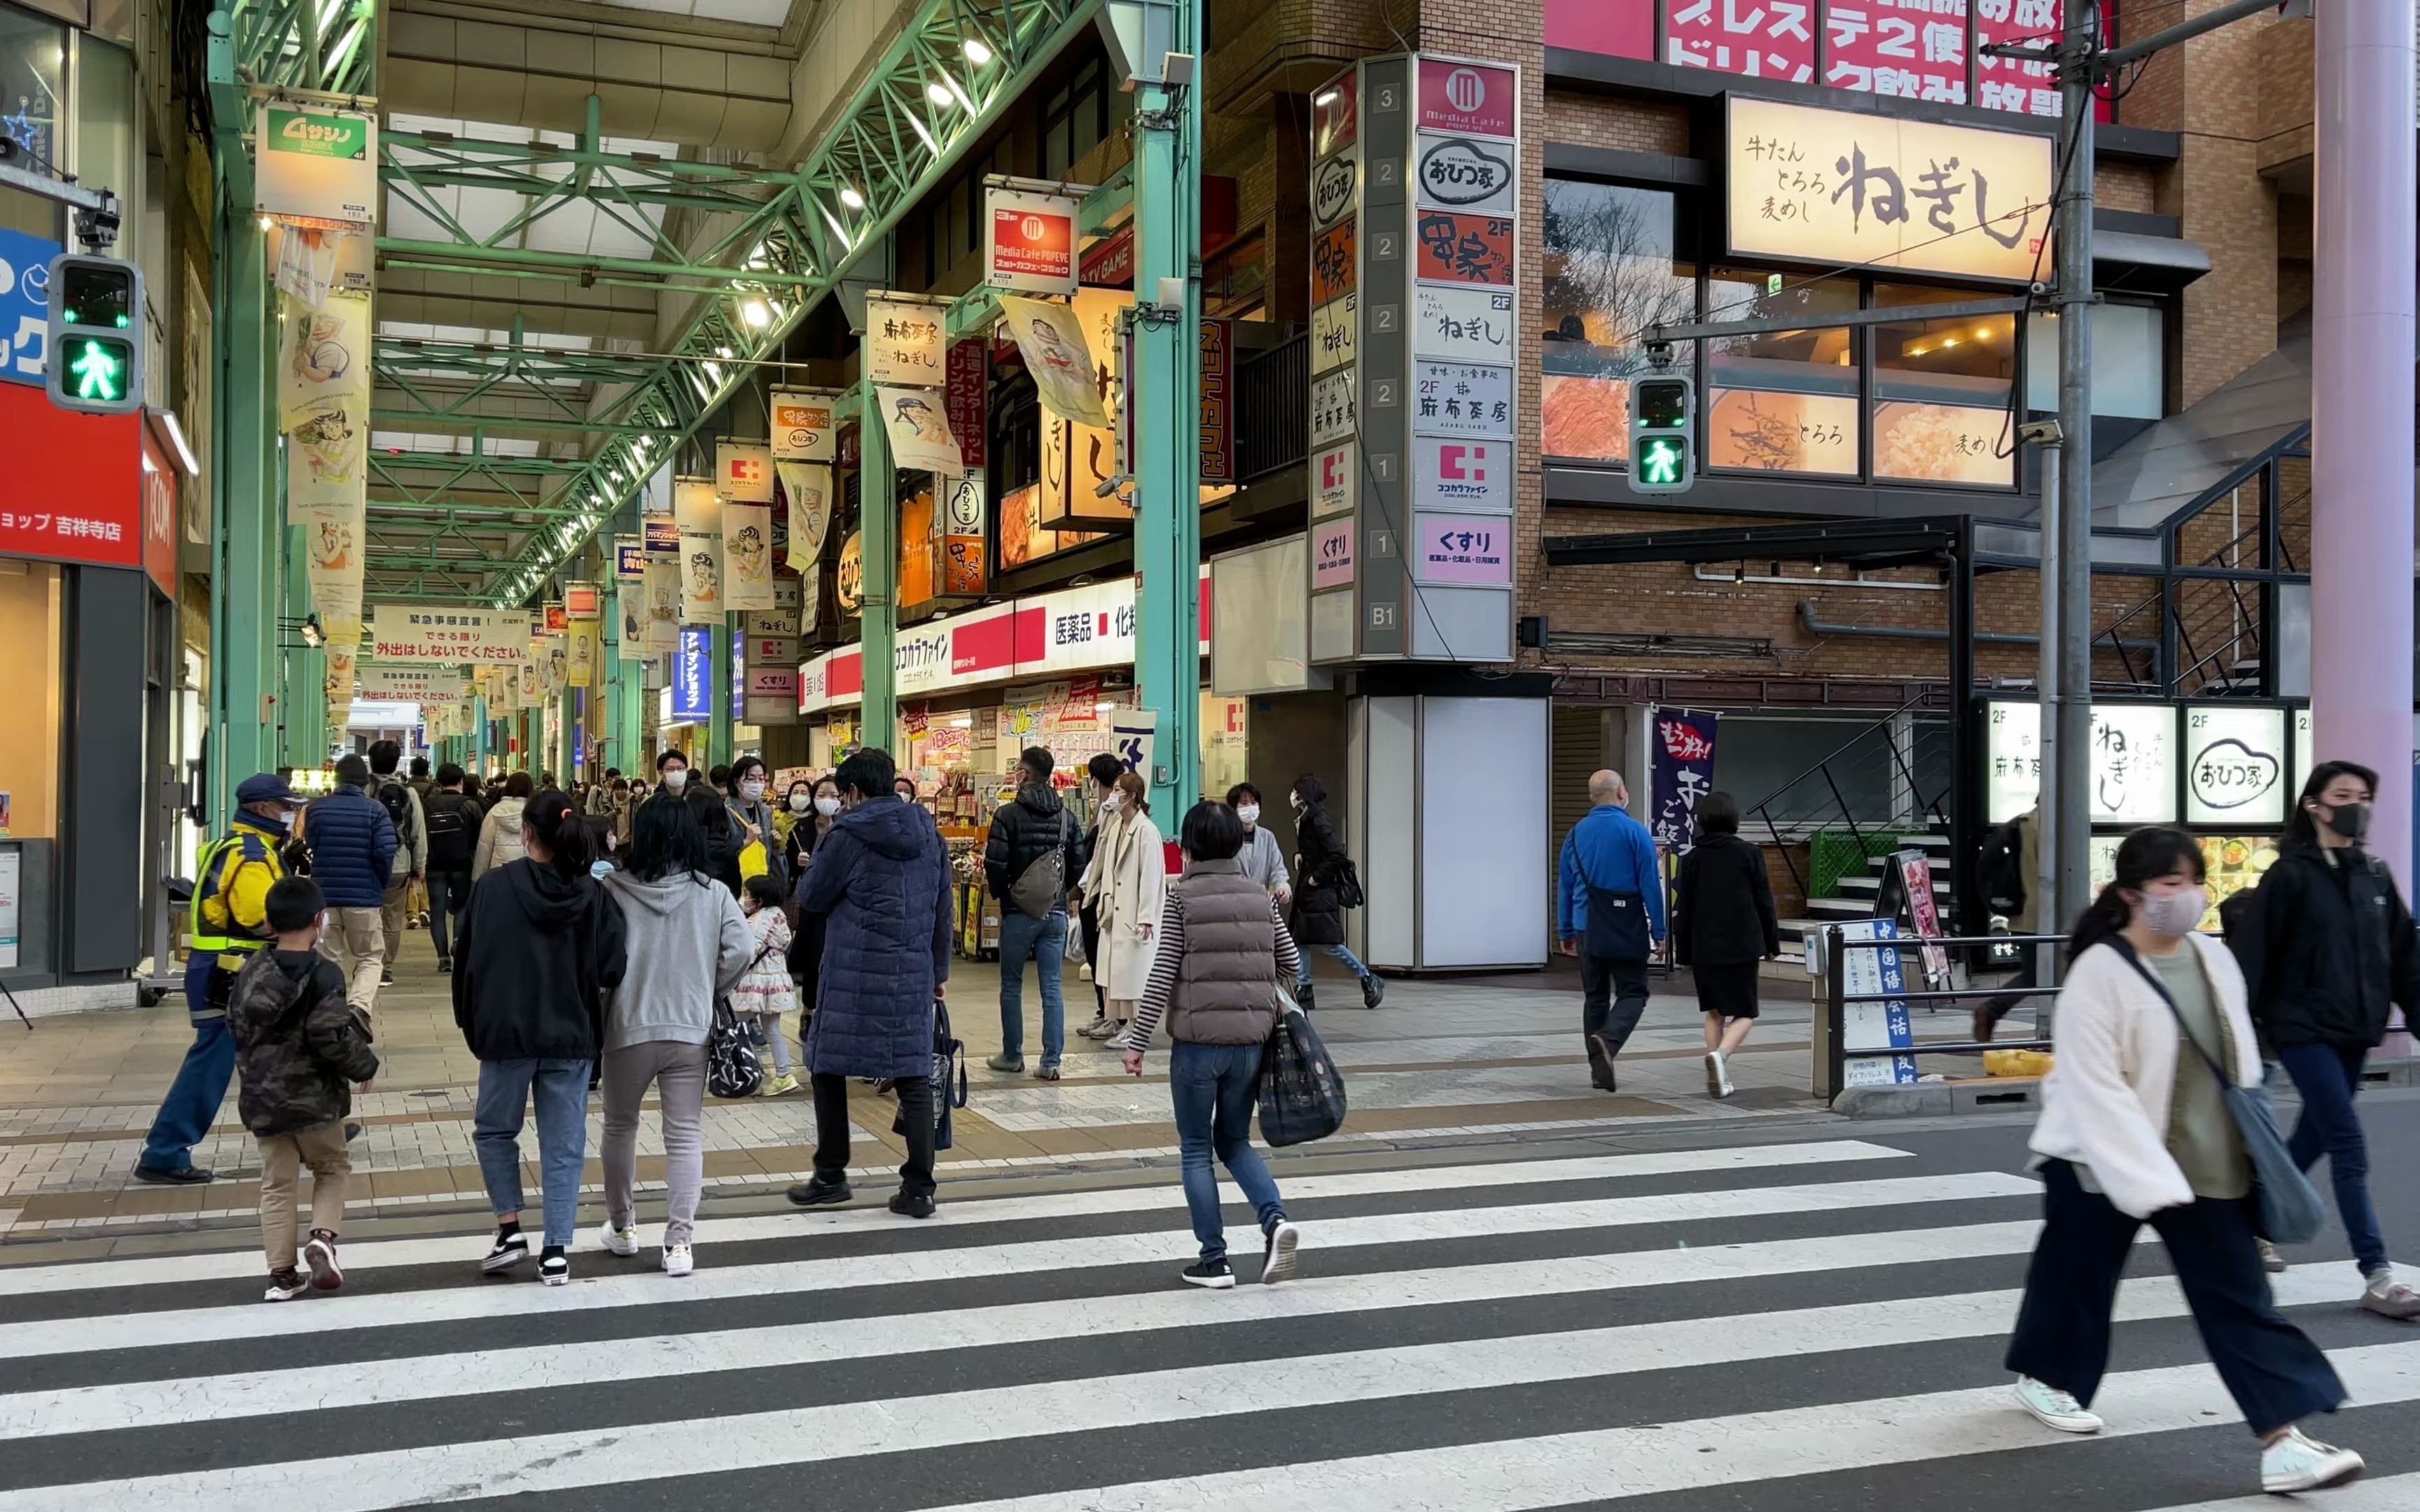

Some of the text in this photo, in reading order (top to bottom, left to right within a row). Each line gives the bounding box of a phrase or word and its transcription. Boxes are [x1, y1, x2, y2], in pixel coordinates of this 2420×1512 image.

[1381, 89, 1393, 107] 3
[283, 117, 352, 143] ムサシノ
[1744, 134, 1805, 162] 牛たん
[1380, 163, 1392, 181] 2
[1429, 158, 1494, 189] おひつ家
[1778, 167, 1826, 195] とろろ
[1831, 140, 2029, 249] ねぎし
[1760, 195, 1809, 223] 麦めし
[1487, 220, 1512, 237] 2F
[996, 245, 1069, 263] Media Cafe POPEYE
[1379, 238, 1391, 255] 2
[1101, 245, 1129, 280] GAME
[1492, 297, 1510, 309] 2F
[1379, 310, 1391, 329] 2
[1438, 314, 1505, 345] ねぎし
[1429, 365, 1499, 379] 甘味・お食事処
[1378, 385, 1390, 403] 2
[1420, 380, 1440, 393] 2F
[1419, 396, 1508, 423] 麻布茶房
[1798, 422, 1843, 446] とろろ
[1379, 458, 1388, 477] 1
[1438, 484, 1489, 493] ココカラファイン
[55, 515, 122, 542] 吉祥寺店
[1323, 534, 1347, 558] くすり
[1378, 535, 1388, 553] 1
[1440, 531, 1491, 553] くすり
[1372, 606, 1393, 625] B1
[426, 631, 481, 641] できる限り
[1055, 612, 1092, 645] 医薬品
[377, 642, 527, 660] 外出はしないでください。
[760, 676, 787, 685] くすり
[1993, 710, 2006, 724] 2F
[2191, 715, 2209, 728] 2F
[2096, 720, 2129, 812] ねぎし
[2201, 761, 2262, 789] おひつ家
